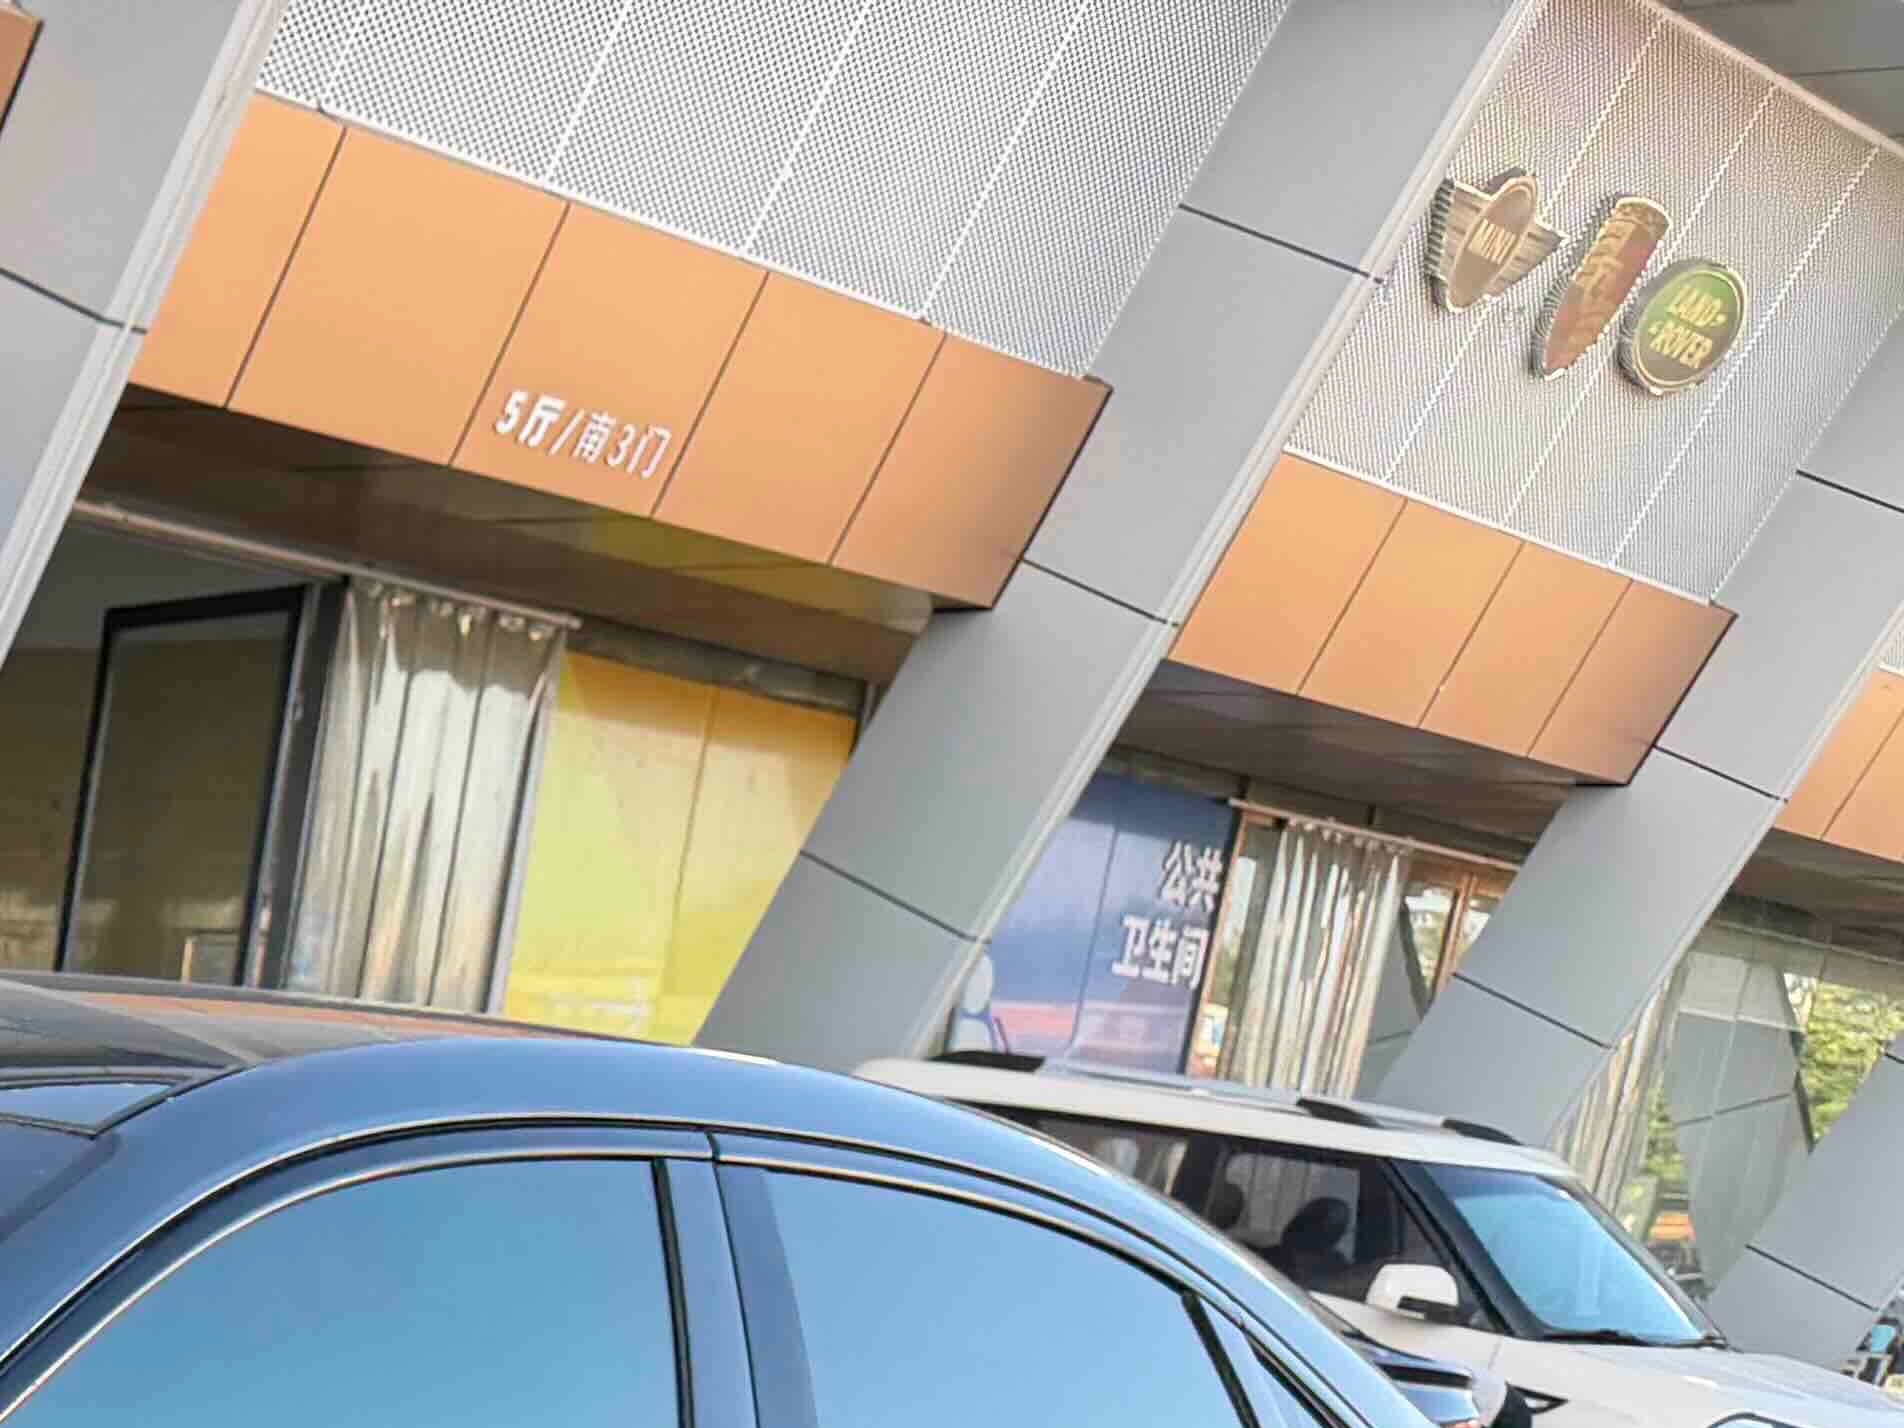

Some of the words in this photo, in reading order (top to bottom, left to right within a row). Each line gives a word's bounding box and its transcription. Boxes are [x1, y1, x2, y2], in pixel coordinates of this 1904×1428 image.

[1468, 218, 1517, 264] MINI
[495, 389, 672, 480] 5厅/南3门
[1160, 841, 1223, 913] 公共
[1111, 914, 1210, 990] 卫生间
